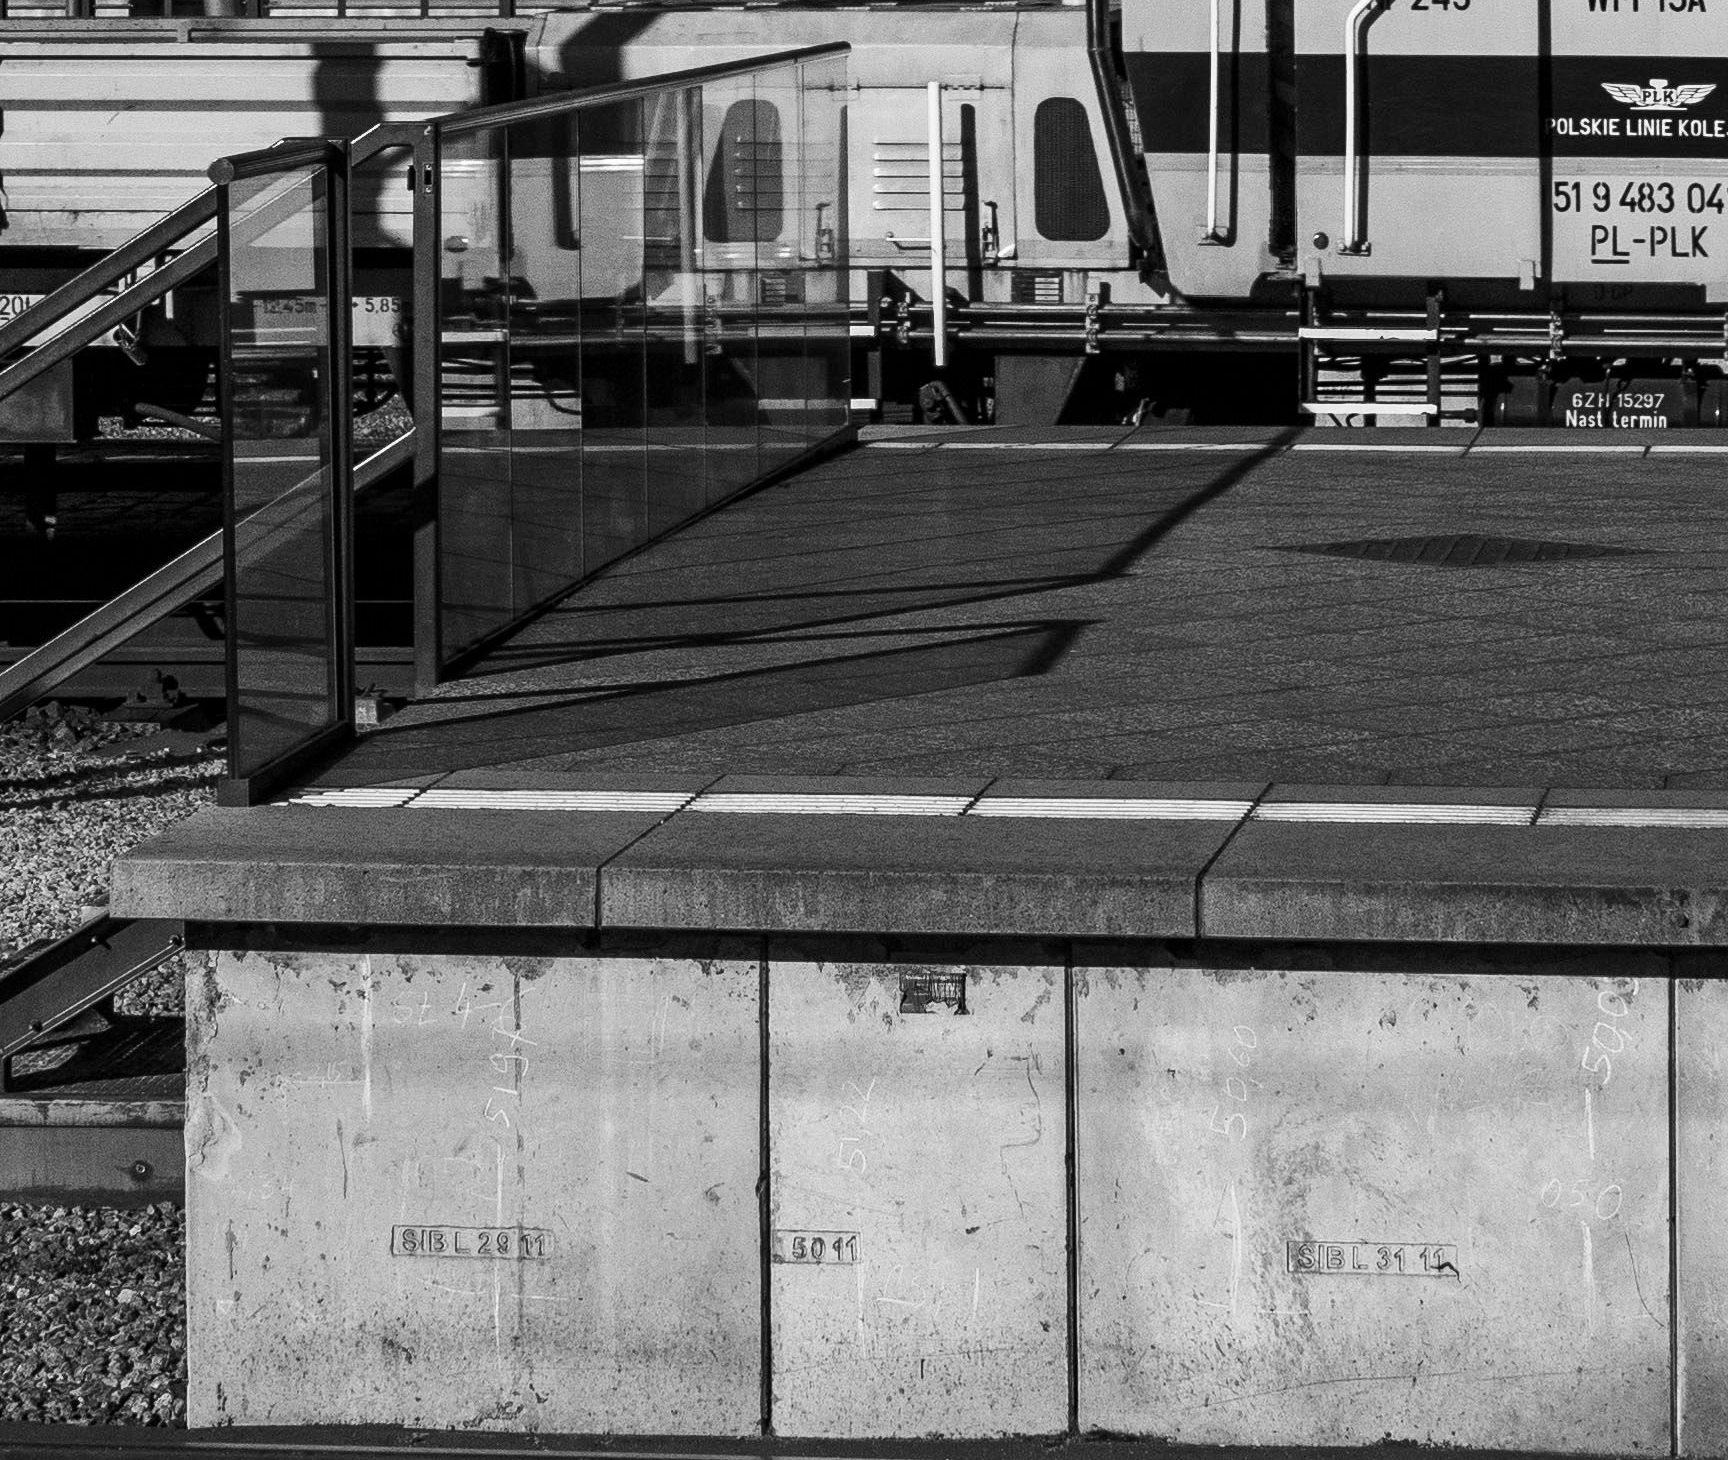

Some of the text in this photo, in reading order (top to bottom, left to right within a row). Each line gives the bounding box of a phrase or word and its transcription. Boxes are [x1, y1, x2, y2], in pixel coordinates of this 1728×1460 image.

[1642, 91, 1675, 104] PLK
[1546, 117, 1620, 136] POLSKIE
[1626, 118, 1672, 137] LINIE
[1553, 181, 1581, 213] 51
[1592, 181, 1611, 213] 9
[1619, 181, 1675, 214] 483
[1590, 224, 1709, 259] PL-PLK
[1617, 393, 1665, 408] 15297
[1565, 409, 1668, 429] Nast termin
[402, 1228, 448, 1253] SIB
[454, 1230, 472, 1254] L
[792, 1236, 827, 1260] 50
[1297, 1243, 1346, 1270] SIB
[1352, 1245, 1369, 1270] L
[1376, 1246, 1406, 1272] 31
